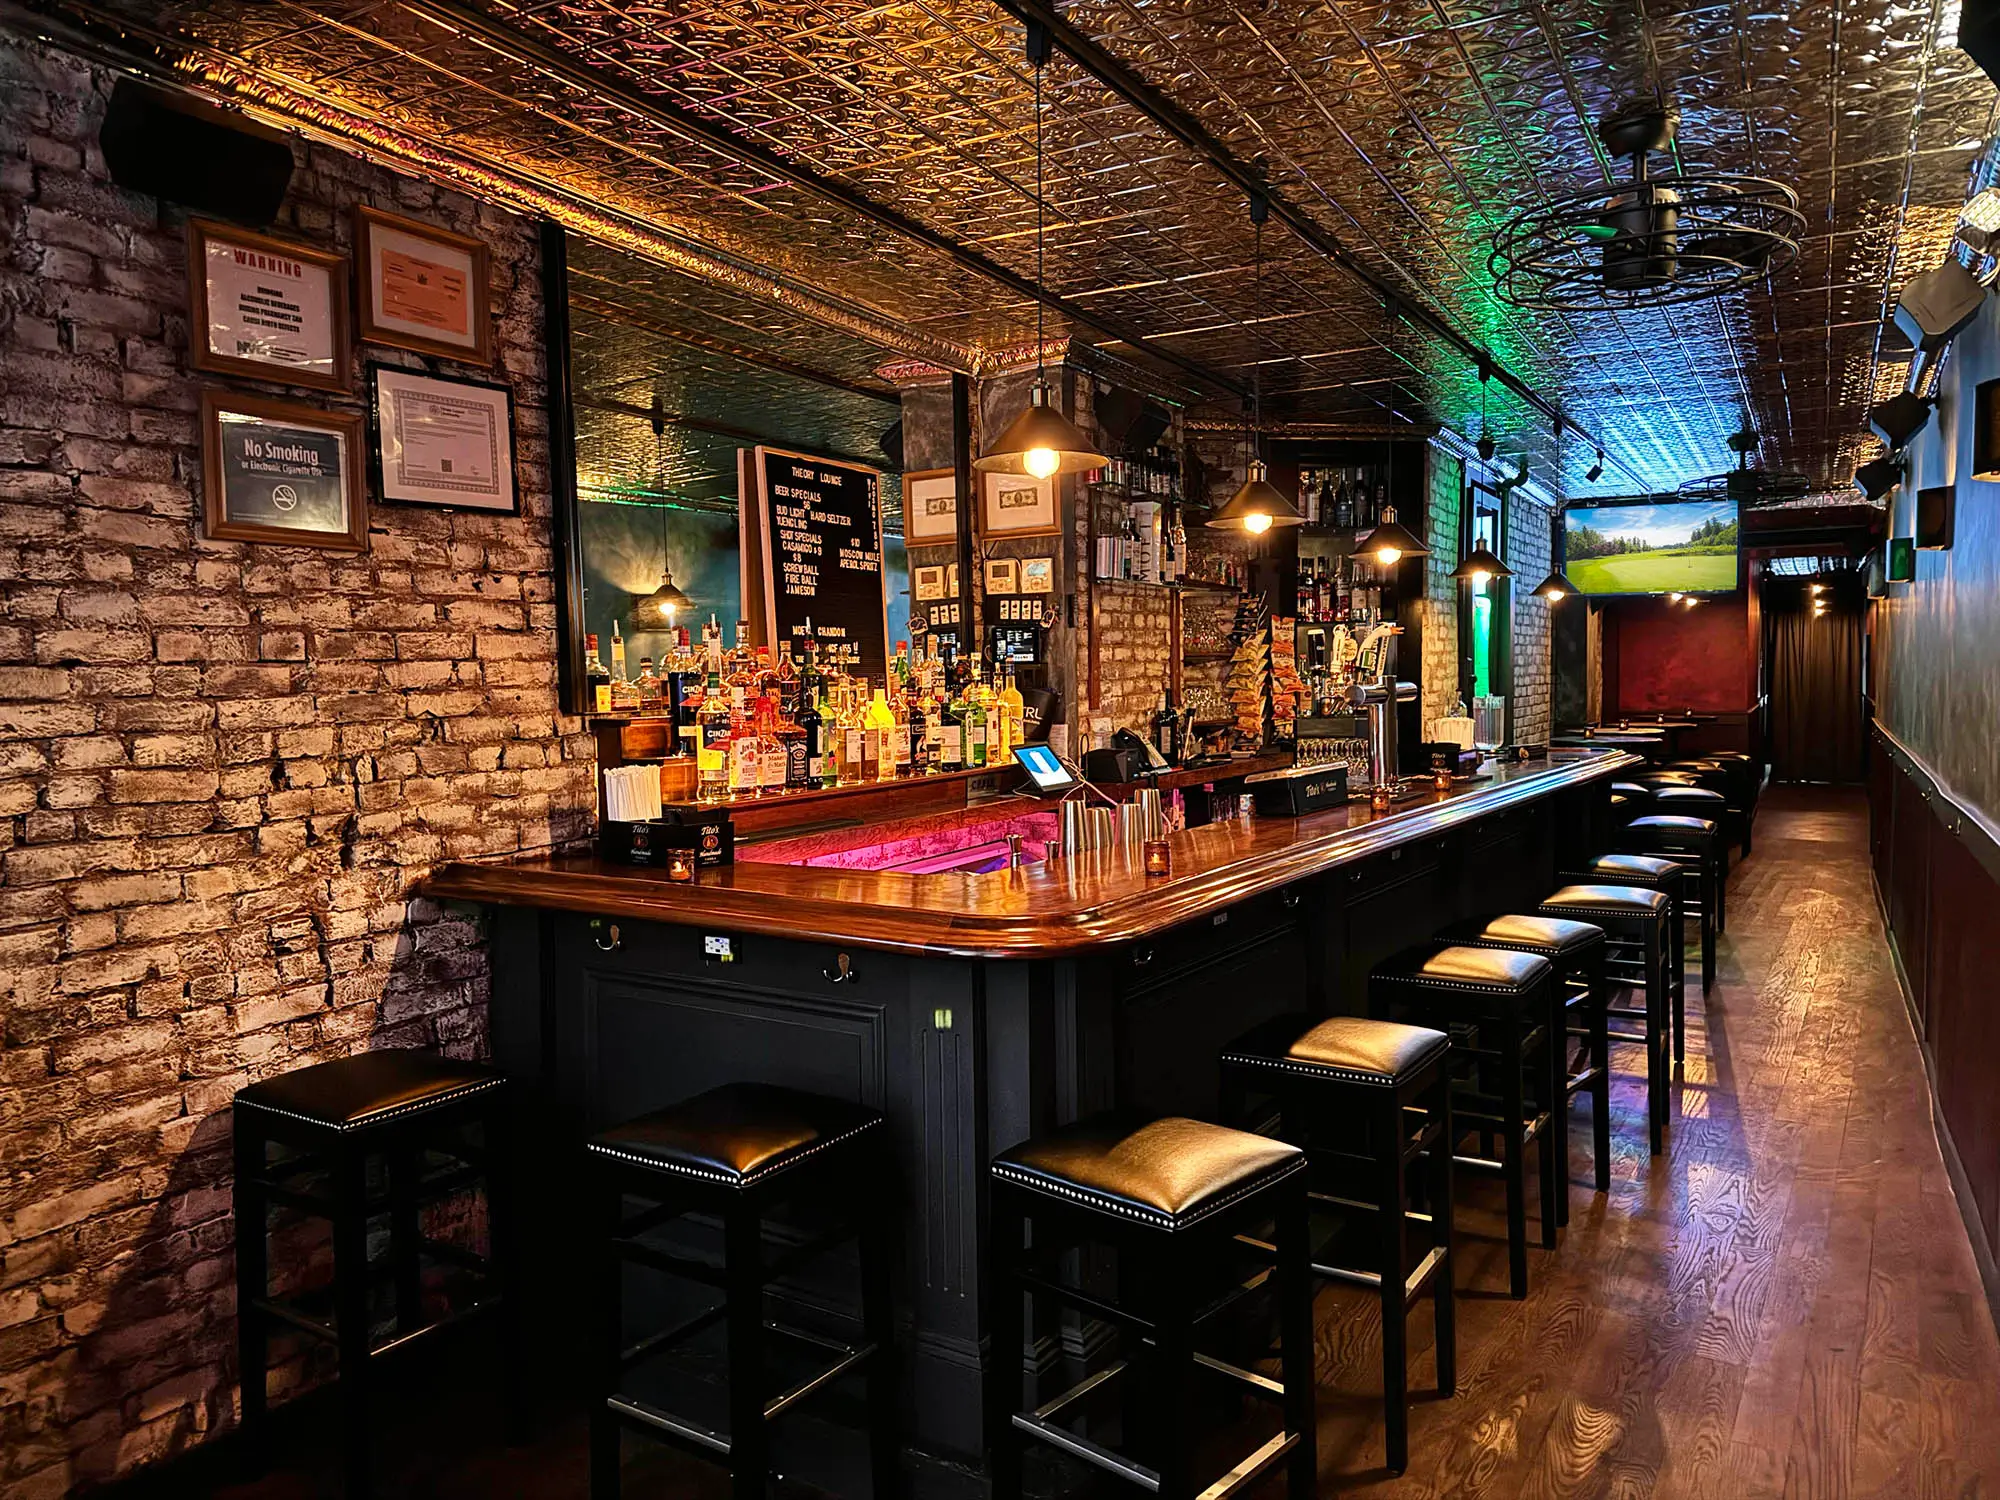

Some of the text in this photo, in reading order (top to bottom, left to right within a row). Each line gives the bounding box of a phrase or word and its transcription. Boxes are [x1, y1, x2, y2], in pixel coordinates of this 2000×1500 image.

[234, 248, 302, 278] WARNING
[244, 438, 319, 466] No Smoking
[241, 461, 249, 469] or
[250, 460, 281, 472] Electronic
[282, 464, 310, 475] Cigarette
[792, 466, 842, 486] THEORY LOUNGE
[774, 484, 821, 502] BEER SPECIALS
[776, 504, 805, 518] BUD LIGHT
[810, 511, 852, 526] HARD SELTZER
[776, 515, 808, 530] YUENGLING
[780, 529, 822, 545] SHOT SPECIALS
[840, 548, 880, 562] MOSCOW MULE
[786, 584, 815, 596] JAMESON
[632, 824, 651, 834] Tito's
[701, 825, 720, 836] Tito's
